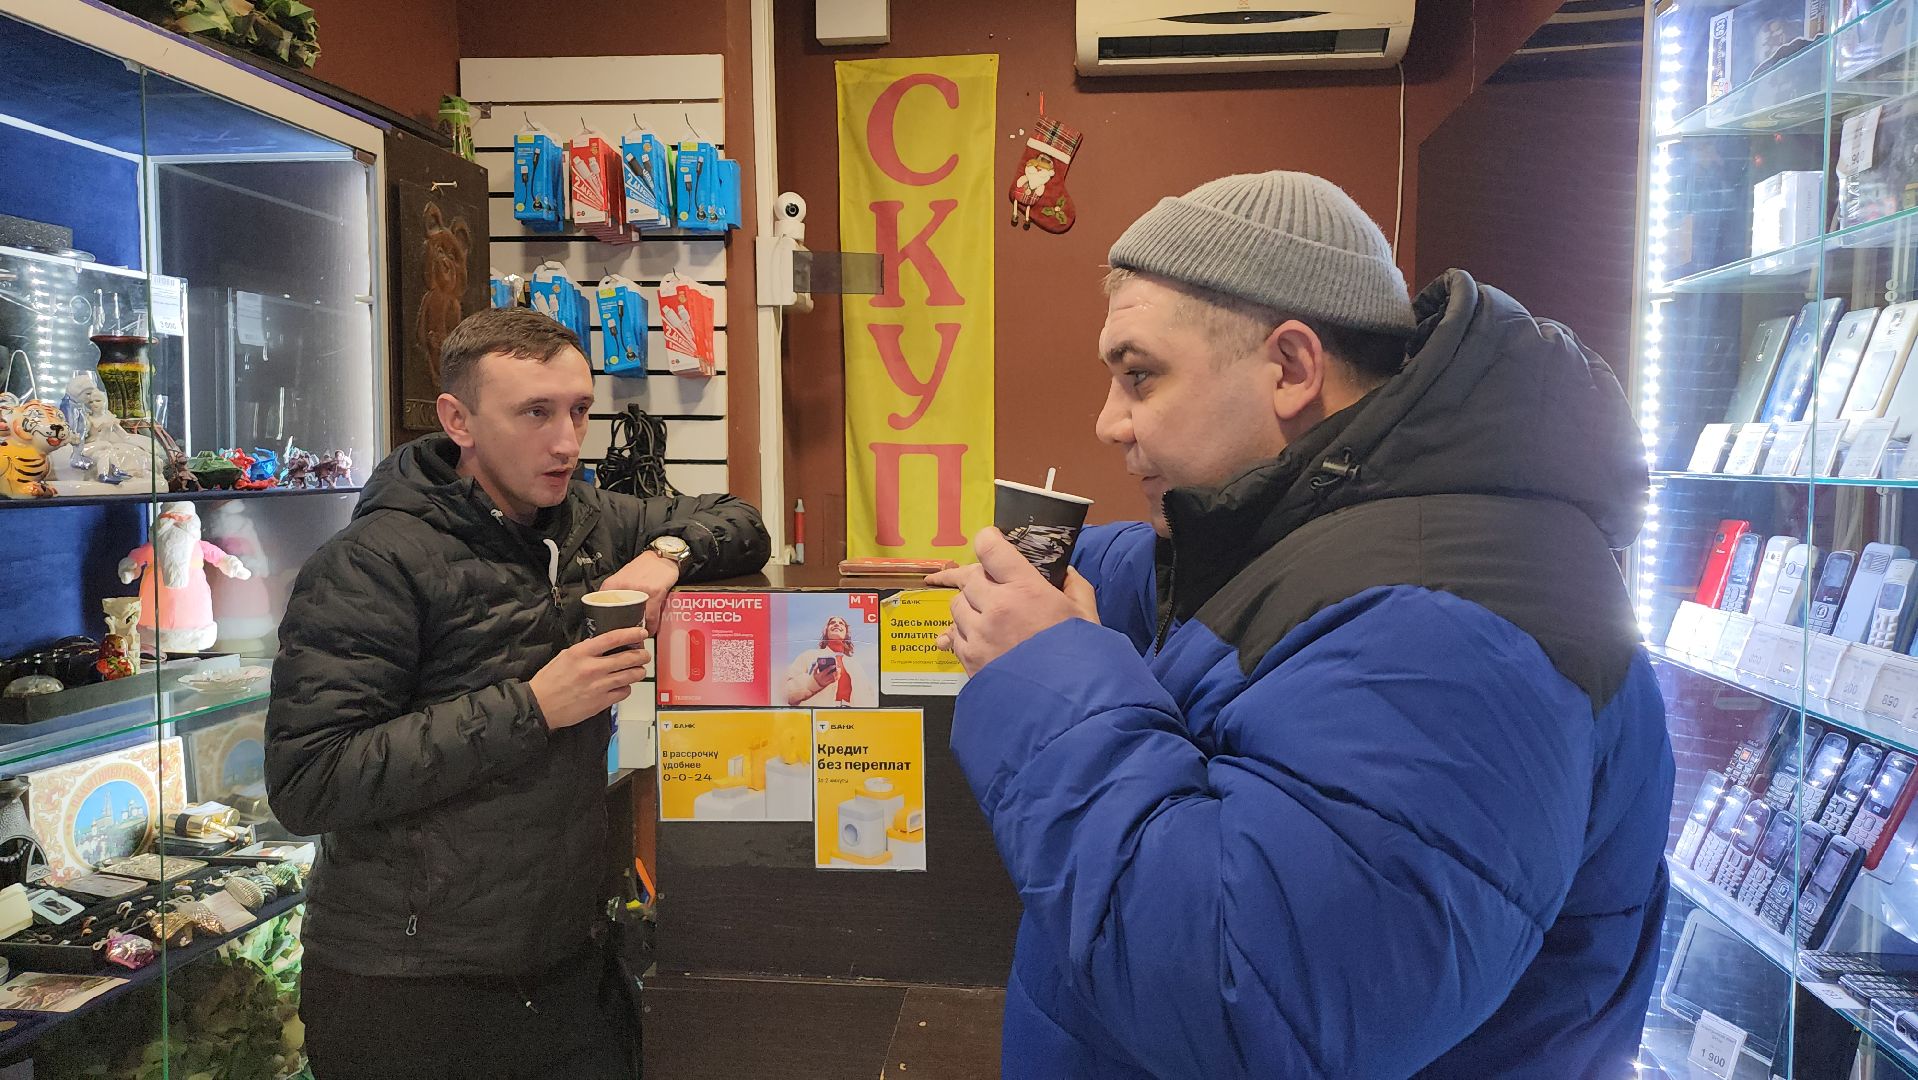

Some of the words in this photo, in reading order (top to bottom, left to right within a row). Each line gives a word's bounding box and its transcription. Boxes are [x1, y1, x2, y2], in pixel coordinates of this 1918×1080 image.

[866, 73, 969, 547] СКУП
[662, 612, 691, 622] МТС
[694, 612, 742, 623] ЗДЕСЬ
[890, 618, 922, 627] Здесь
[924, 619, 954, 627] можн
[899, 645, 955, 654] рассроу
[670, 751, 719, 759] рассрочку
[817, 743, 869, 757] Кредит
[662, 760, 701, 770] удобнее
[817, 757, 842, 770] без
[845, 761, 911, 772] переплат
